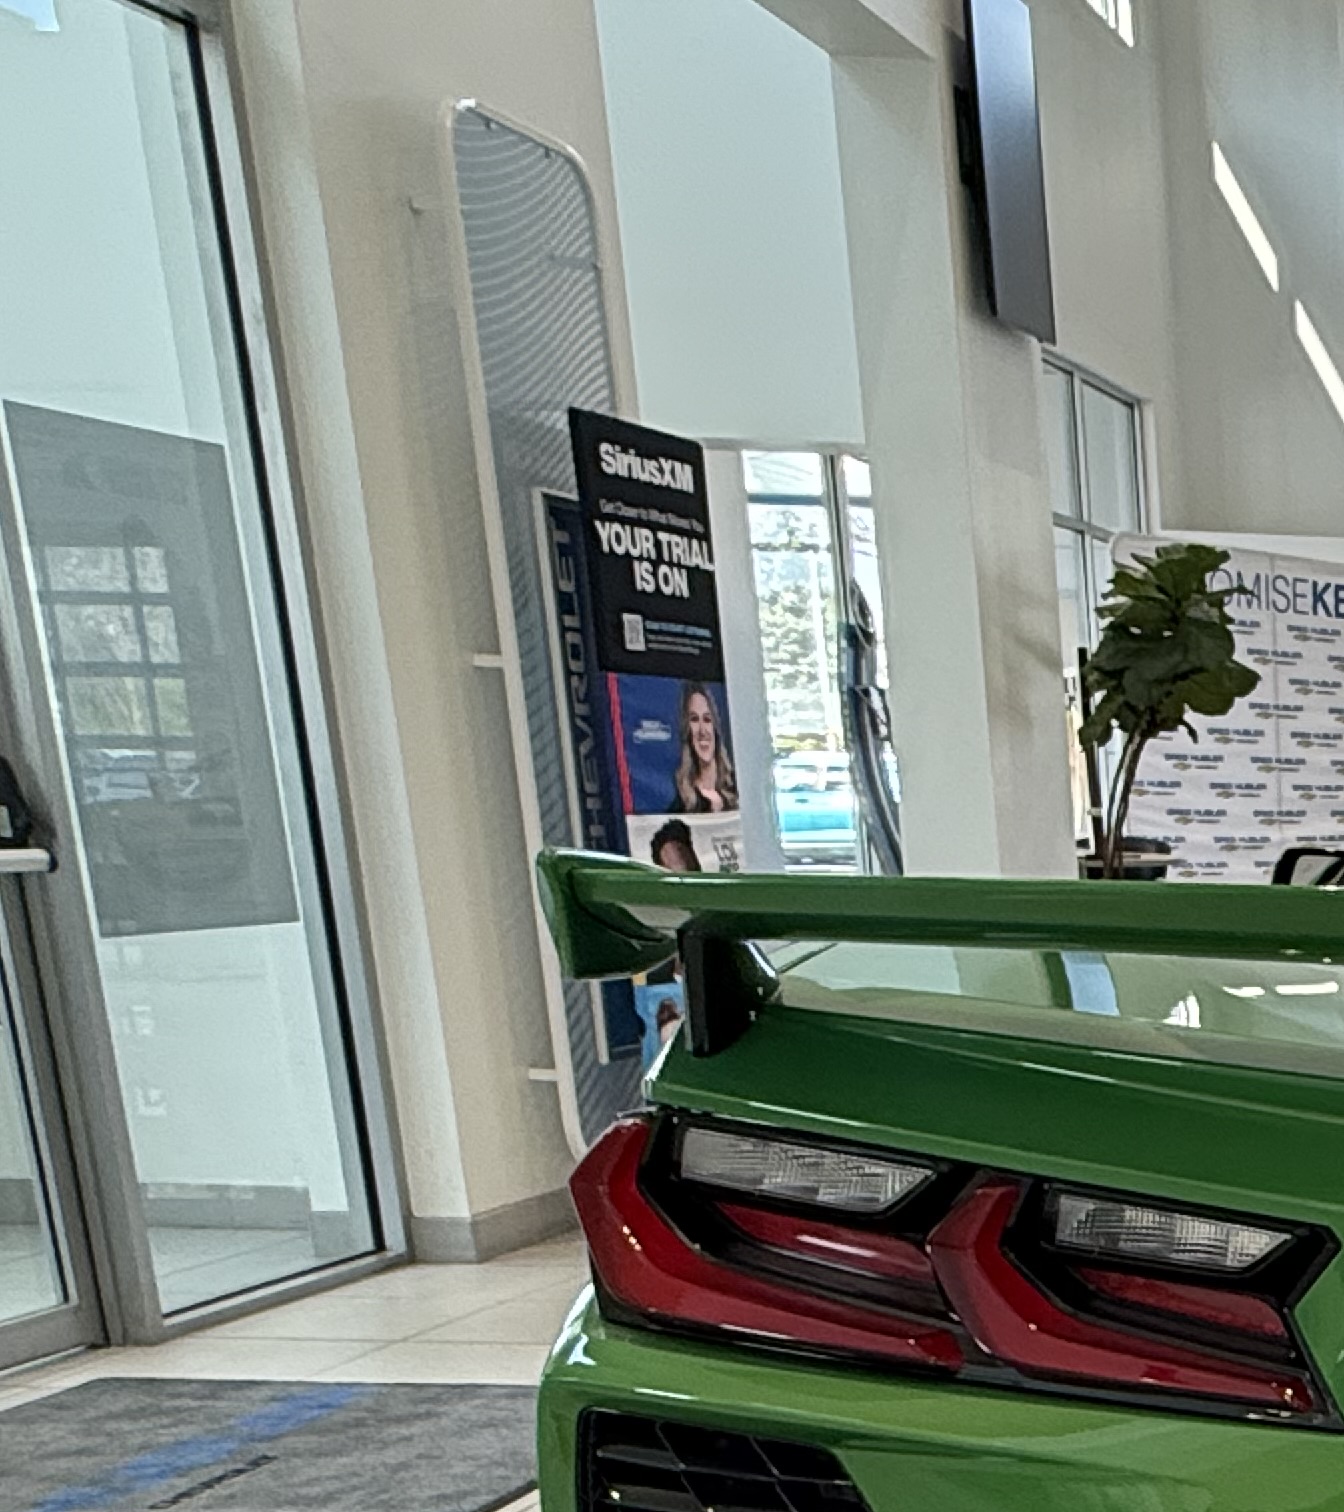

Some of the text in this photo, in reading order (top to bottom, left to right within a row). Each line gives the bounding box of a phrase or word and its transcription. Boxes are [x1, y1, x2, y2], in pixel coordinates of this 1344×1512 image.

[599, 442, 694, 494] SiriusXM
[594, 519, 716, 572] YOUR TRIAL
[632, 559, 690, 600] IS ON
[551, 511, 607, 849] HEVROLET
